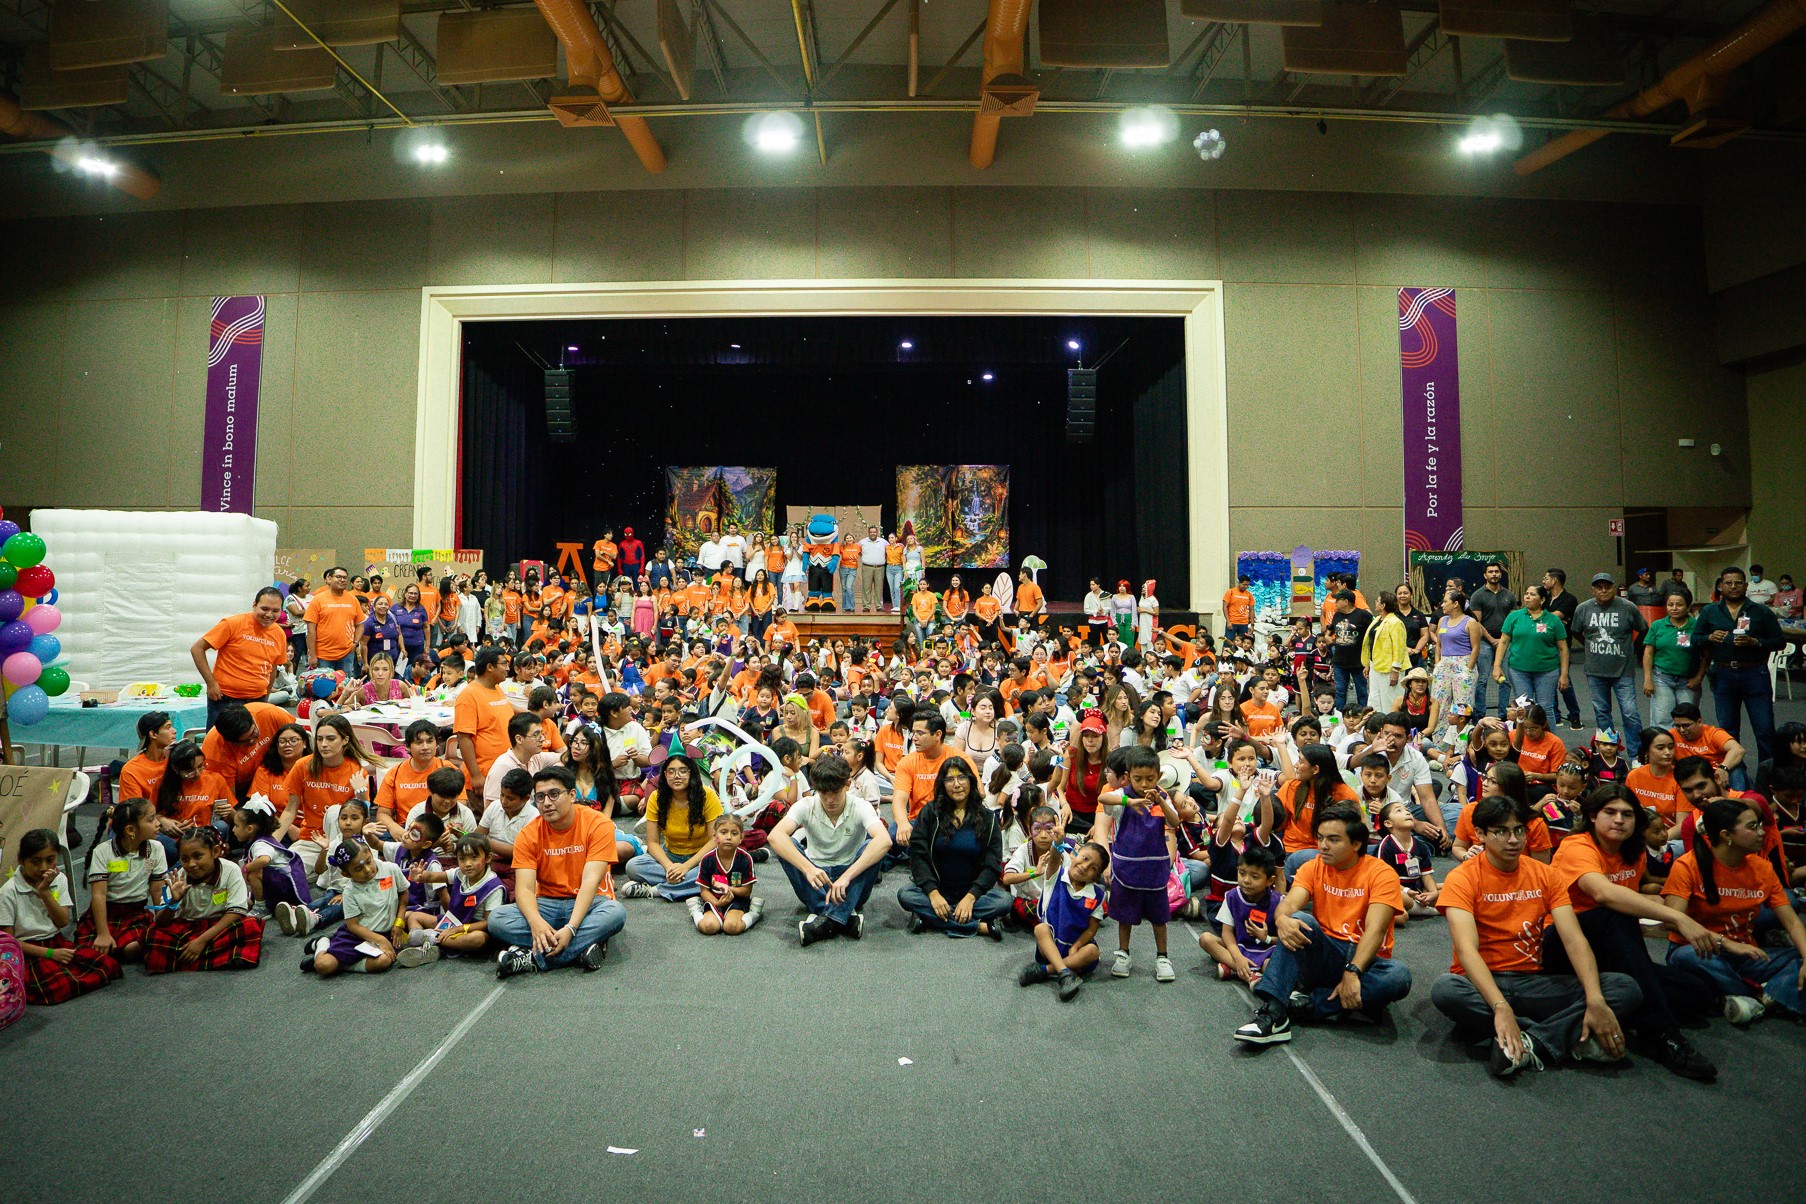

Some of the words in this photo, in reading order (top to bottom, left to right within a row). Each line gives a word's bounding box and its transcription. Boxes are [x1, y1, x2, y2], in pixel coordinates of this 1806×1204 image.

[225, 363, 238, 413] malum
[1423, 381, 1436, 423] razón
[222, 415, 235, 451] bono
[1424, 426, 1436, 441] la
[1427, 443, 1439, 454] y
[221, 454, 233, 468] in
[1425, 456, 1437, 471] fe
[1425, 474, 1437, 489] la
[220, 471, 232, 512] Vince
[1427, 492, 1438, 518] Por
[275, 555, 292, 567] LCE
[1588, 612, 1619, 627] AME
[1589, 641, 1624, 656] RICAN.
[0, 770, 29, 797] OÉ
